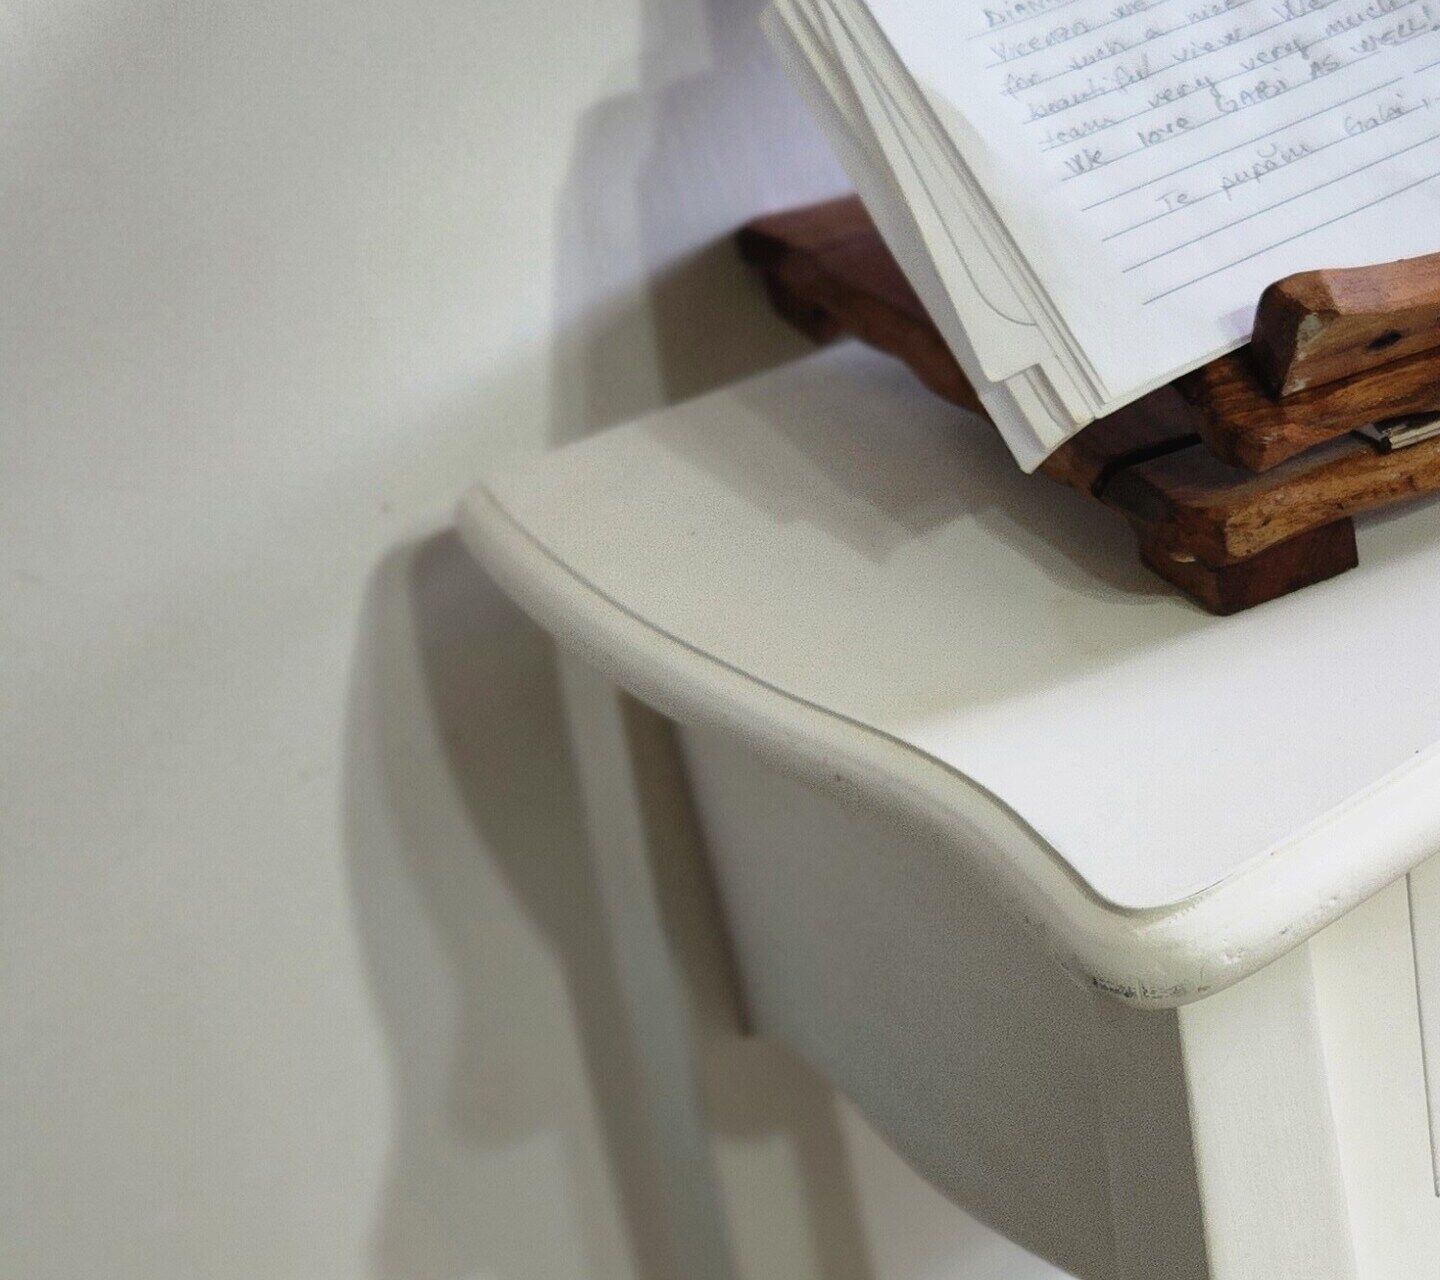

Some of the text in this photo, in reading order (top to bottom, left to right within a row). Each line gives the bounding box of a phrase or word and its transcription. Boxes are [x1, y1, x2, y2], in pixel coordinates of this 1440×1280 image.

[1149, 74, 1218, 109] very
[1136, 116, 1192, 148] love
[1154, 189, 1190, 211] Te
